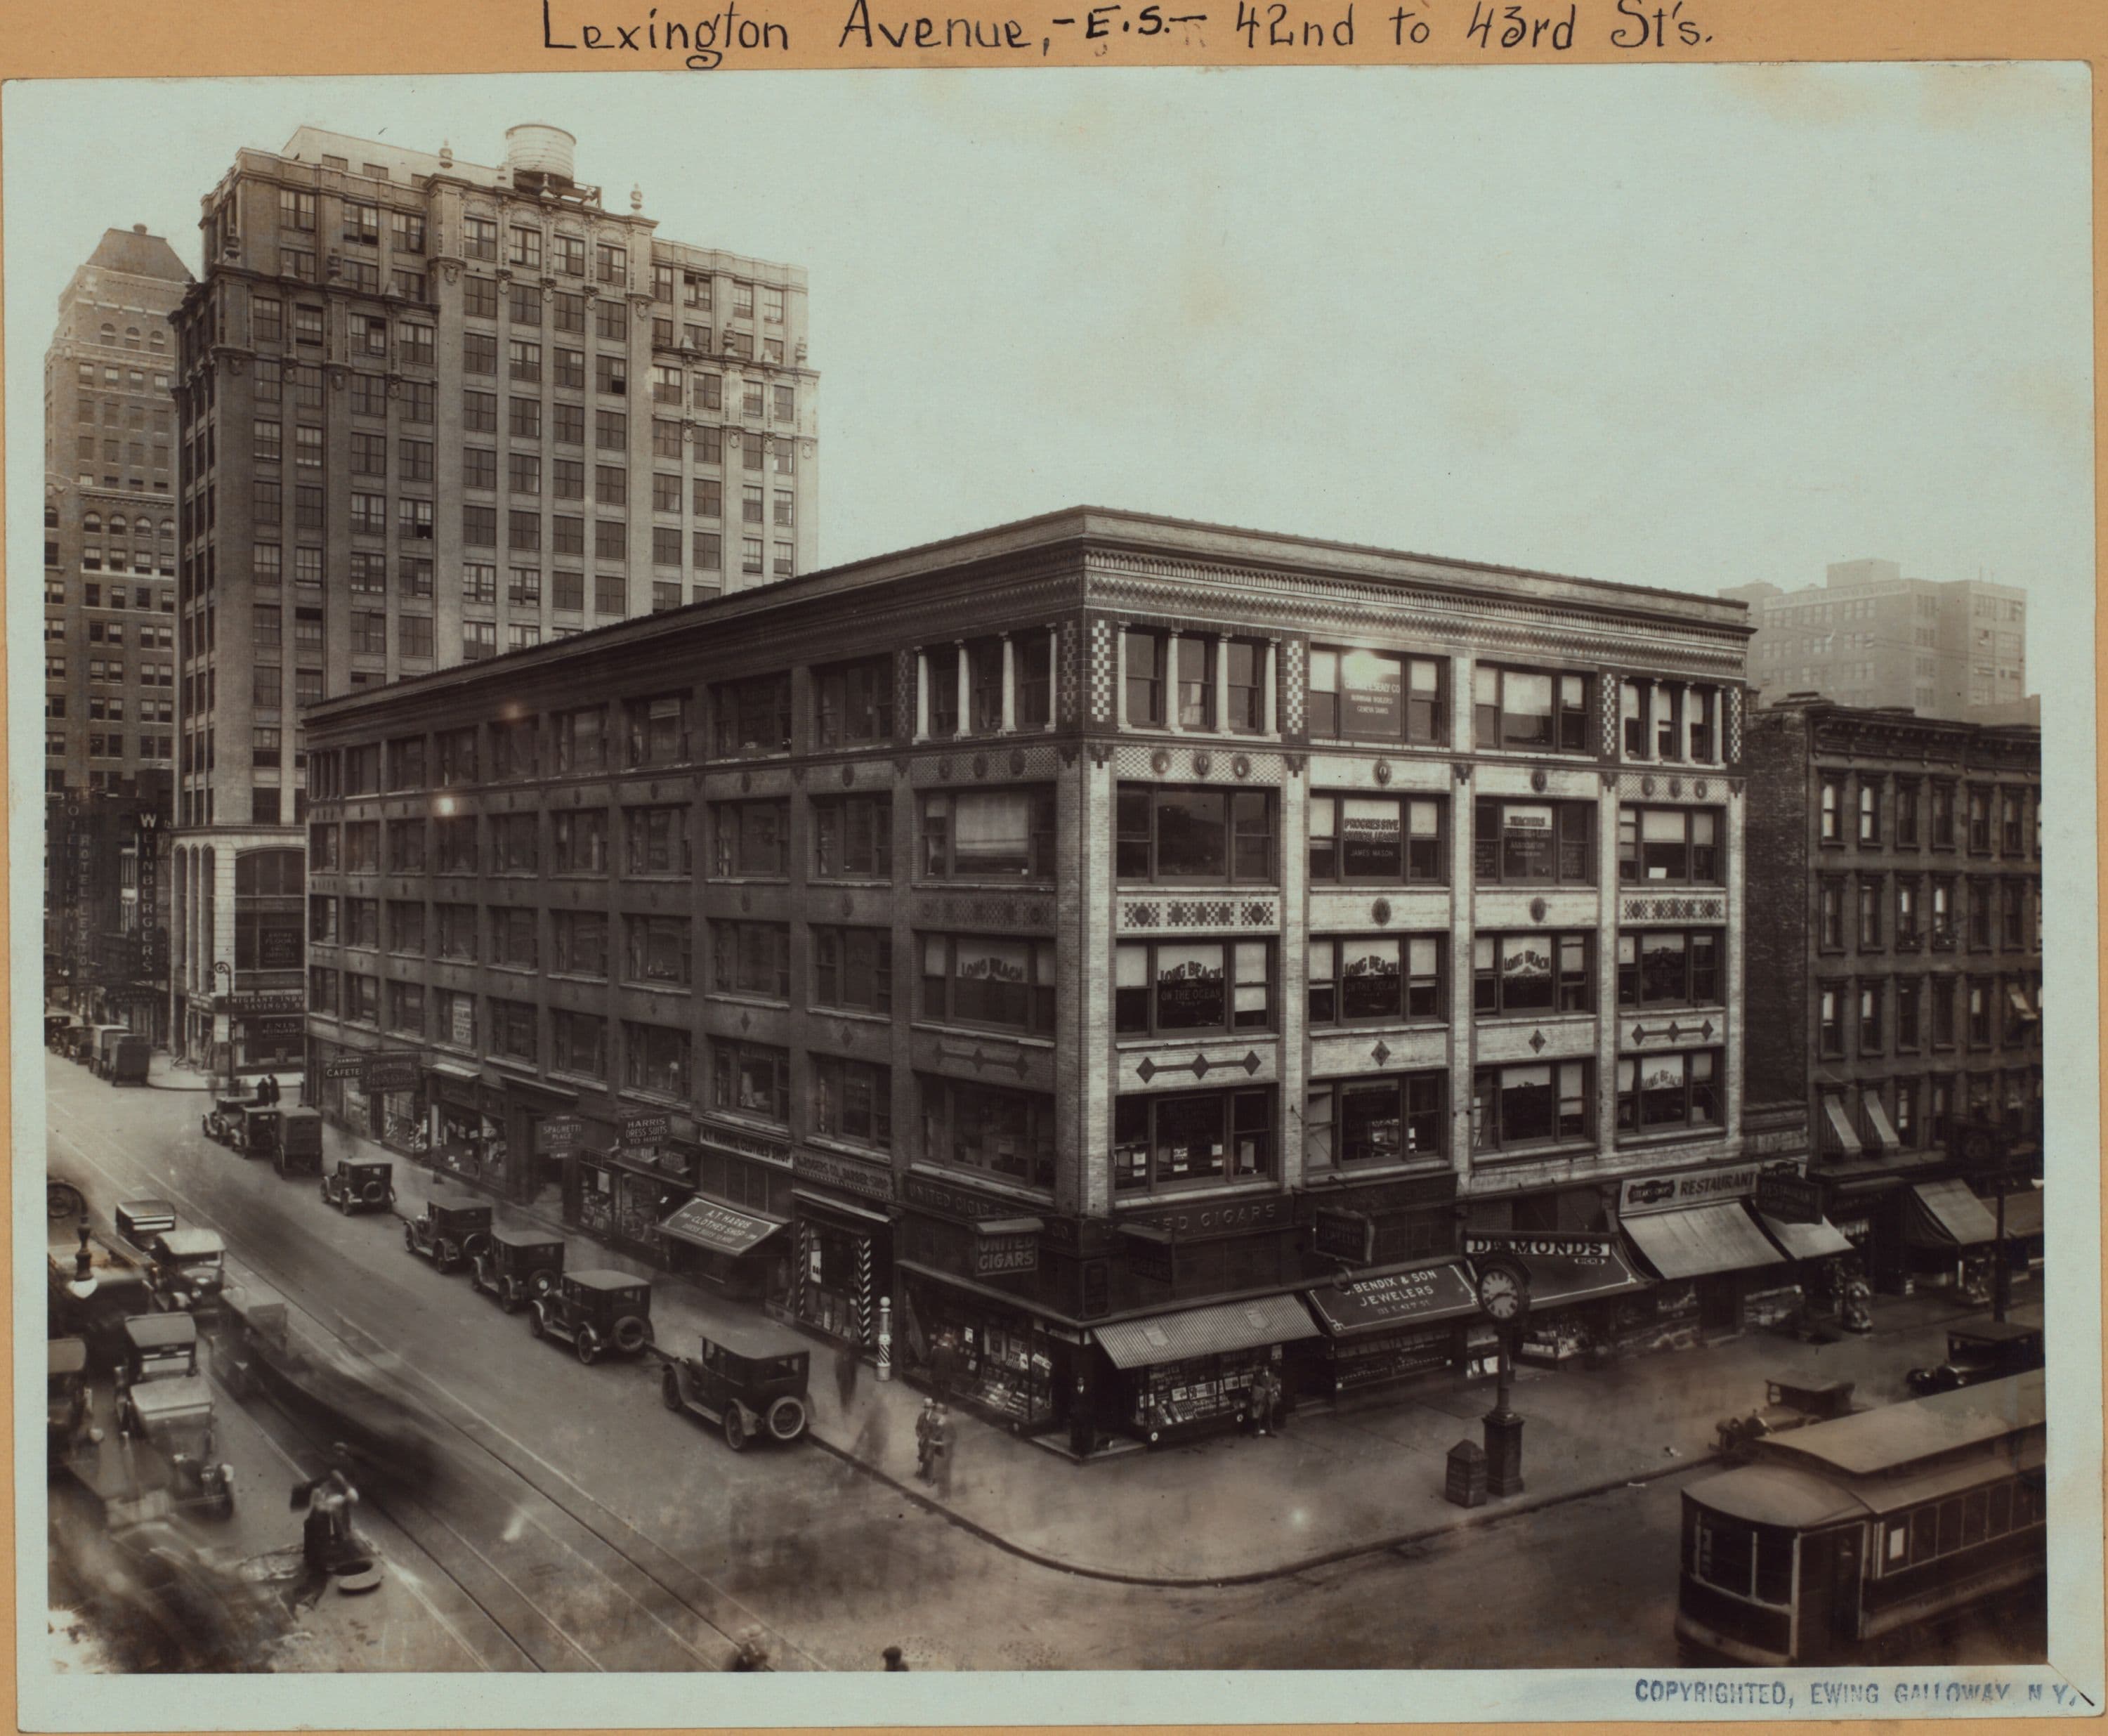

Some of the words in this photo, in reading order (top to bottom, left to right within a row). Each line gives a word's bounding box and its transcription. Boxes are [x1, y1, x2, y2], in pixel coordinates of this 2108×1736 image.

[544, 0, 787, 70] Lexington
[839, 0, 1051, 56] Avenue,
[1236, 4, 1354, 48] 42nd
[1390, 6, 1429, 45] to
[1467, 3, 1573, 49] 43rd
[1344, 818, 1399, 830] PROGRESSIVE
[1372, 849, 1394, 857] MASON
[79, 834, 91, 898] HOTEL
[140, 813, 157, 973] WEINBERGER'S
[962, 959, 987, 977] LONG
[990, 957, 1022, 981] BEACH
[1344, 956, 1367, 976] LONG
[1369, 955, 1397, 975] BEACH
[1505, 952, 1524, 971] LONG
[1525, 950, 1549, 970] BEACH
[1161, 963, 1185, 984] LONG
[1188, 960, 1221, 983] BEACH
[225, 996, 274, 1005] EMIGRANT
[1161, 990, 1172, 1001] ON
[1174, 989, 1190, 1000] THE
[1192, 988, 1220, 1000] OCEAN
[243, 1003, 288, 1012] SAVINGS
[1660, 1069, 1682, 1085] BEACH
[543, 1124, 582, 1135] SPAGHETTI
[625, 1127, 648, 1139] DRESS
[648, 1125, 668, 1136] SUITS
[627, 1118, 666, 1128] HARRIS
[1680, 1171, 1756, 1197] RESTAURANT
[908, 1183, 950, 1208] UNITED
[721, 1214, 753, 1229] HARRIS
[1200, 1203, 1276, 1227] CIGARS
[691, 1215, 727, 1232] CLOTHES
[724, 1226, 746, 1237] SHOP
[978, 1234, 1034, 1251] UNITED
[1474, 1239, 1602, 1255] DMONDS
[978, 1251, 1034, 1270] CIGARS
[1400, 1275, 1409, 1285] &
[1411, 1270, 1437, 1282] SON
[1360, 1285, 1434, 1307] JEWELERS
